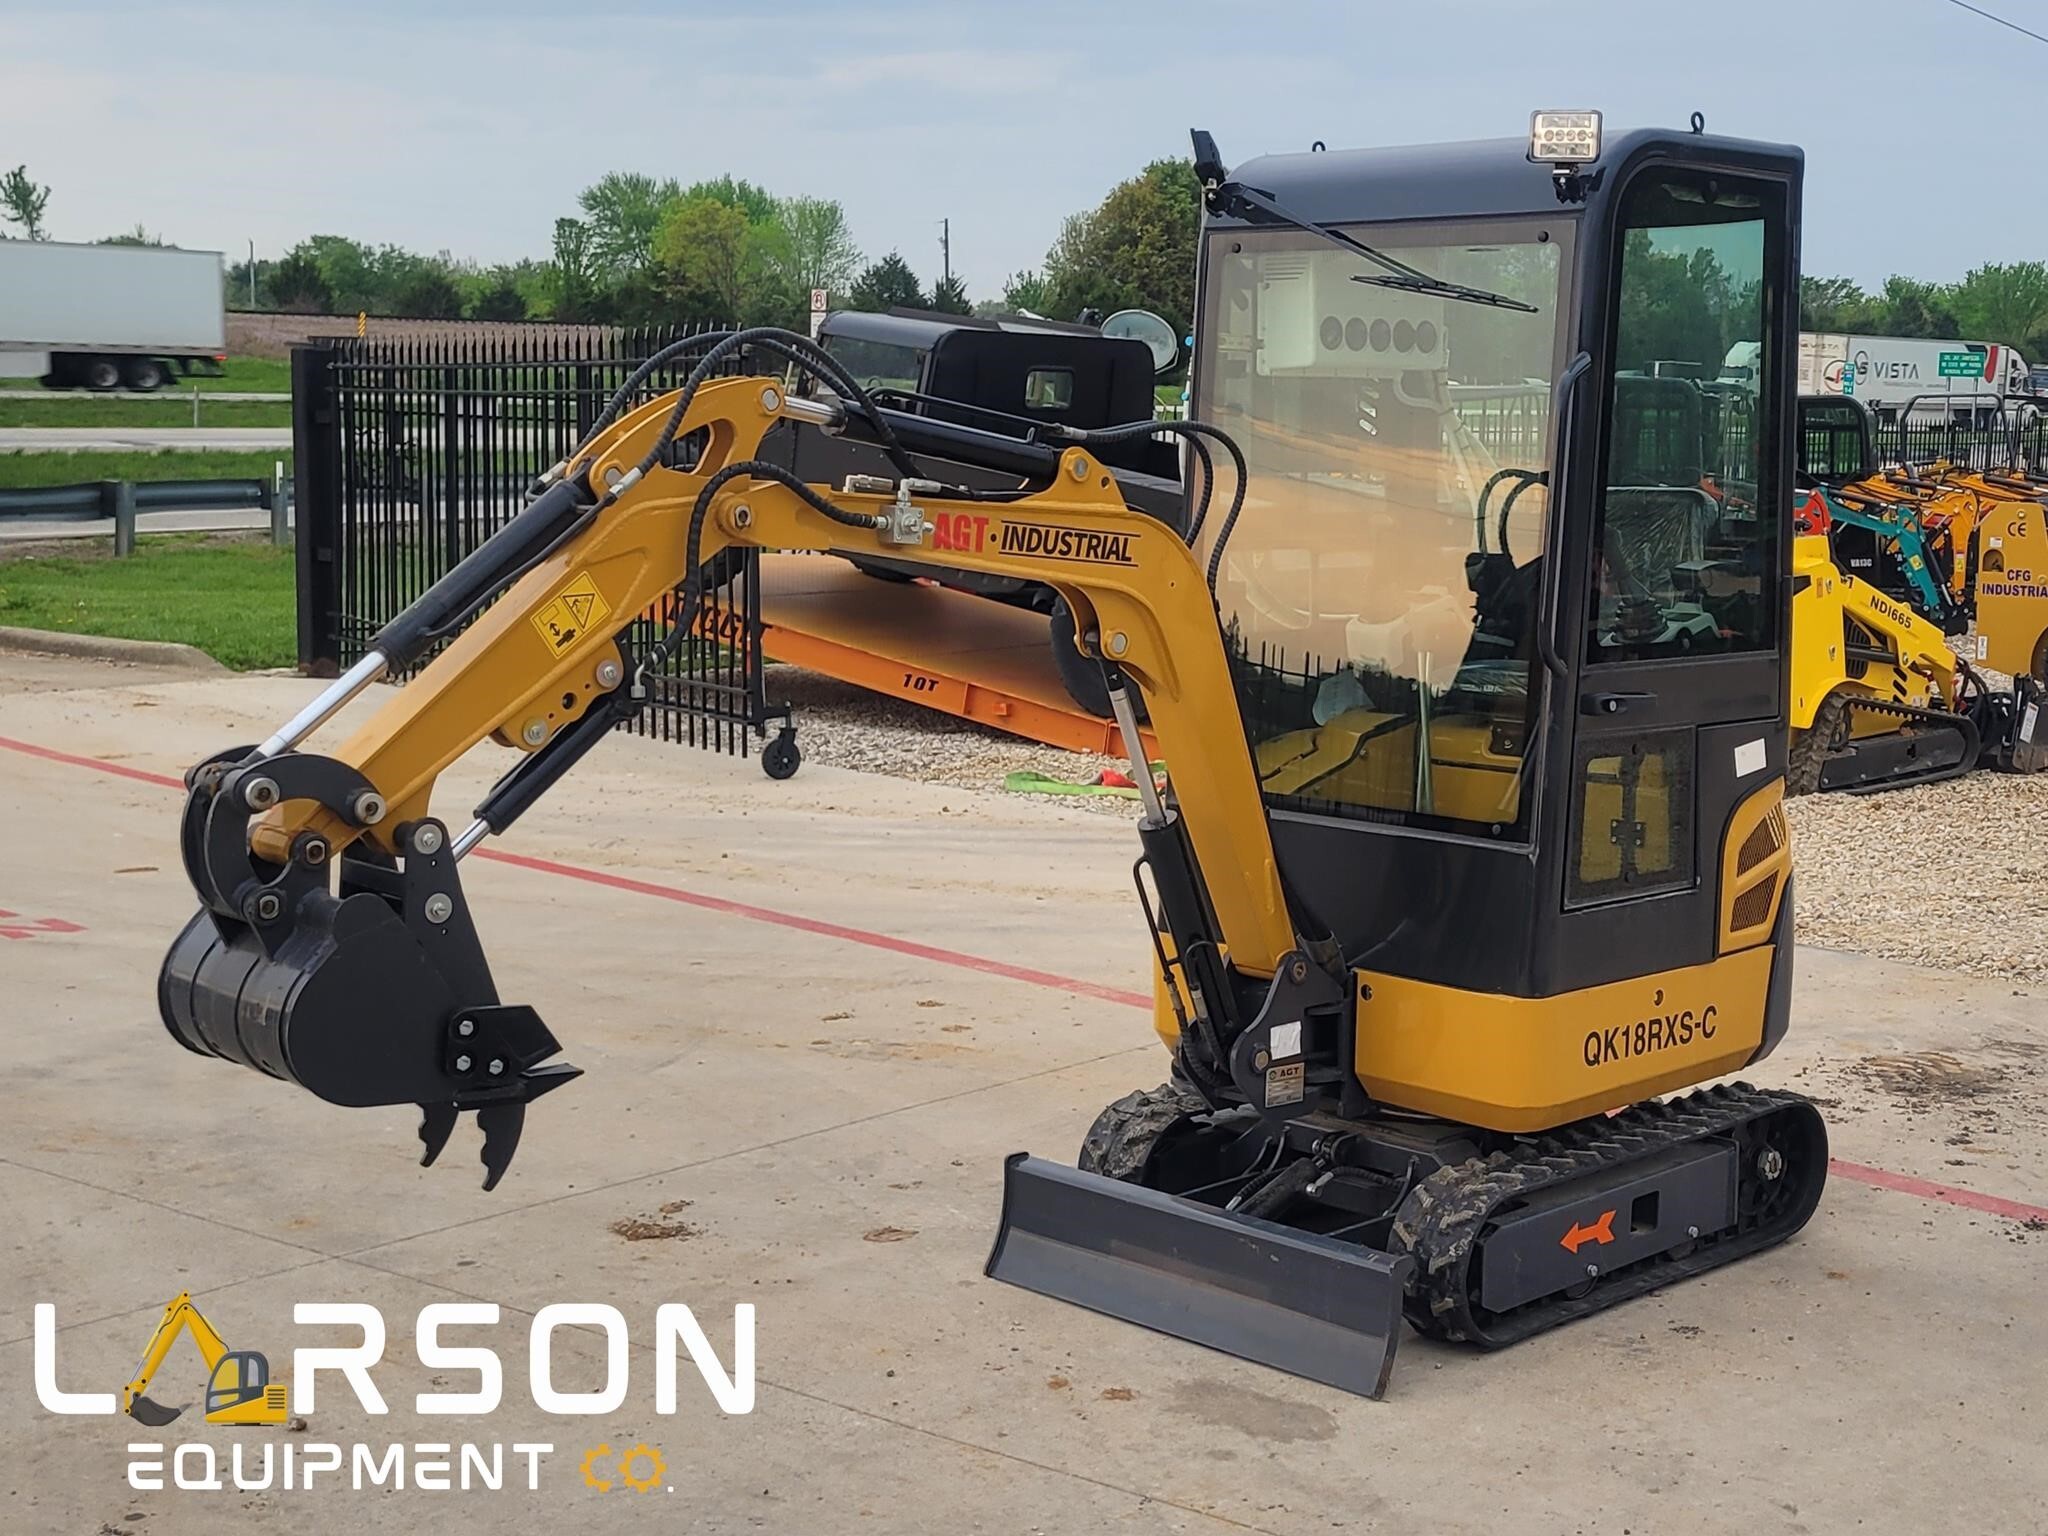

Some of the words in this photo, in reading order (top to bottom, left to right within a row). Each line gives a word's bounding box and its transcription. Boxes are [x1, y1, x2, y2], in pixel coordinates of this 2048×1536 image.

[1874, 361, 1919, 380] VISTA
[933, 512, 990, 553] AGT
[1001, 524, 1133, 563] INDUSTRIAL
[2007, 521, 2028, 538] CE
[2006, 569, 2032, 582] CFG
[1869, 595, 1913, 630] NDI665
[903, 673, 940, 692] 10T
[1583, 1004, 1717, 1066] QK18RXS-C
[1280, 1066, 1300, 1077] AGT
